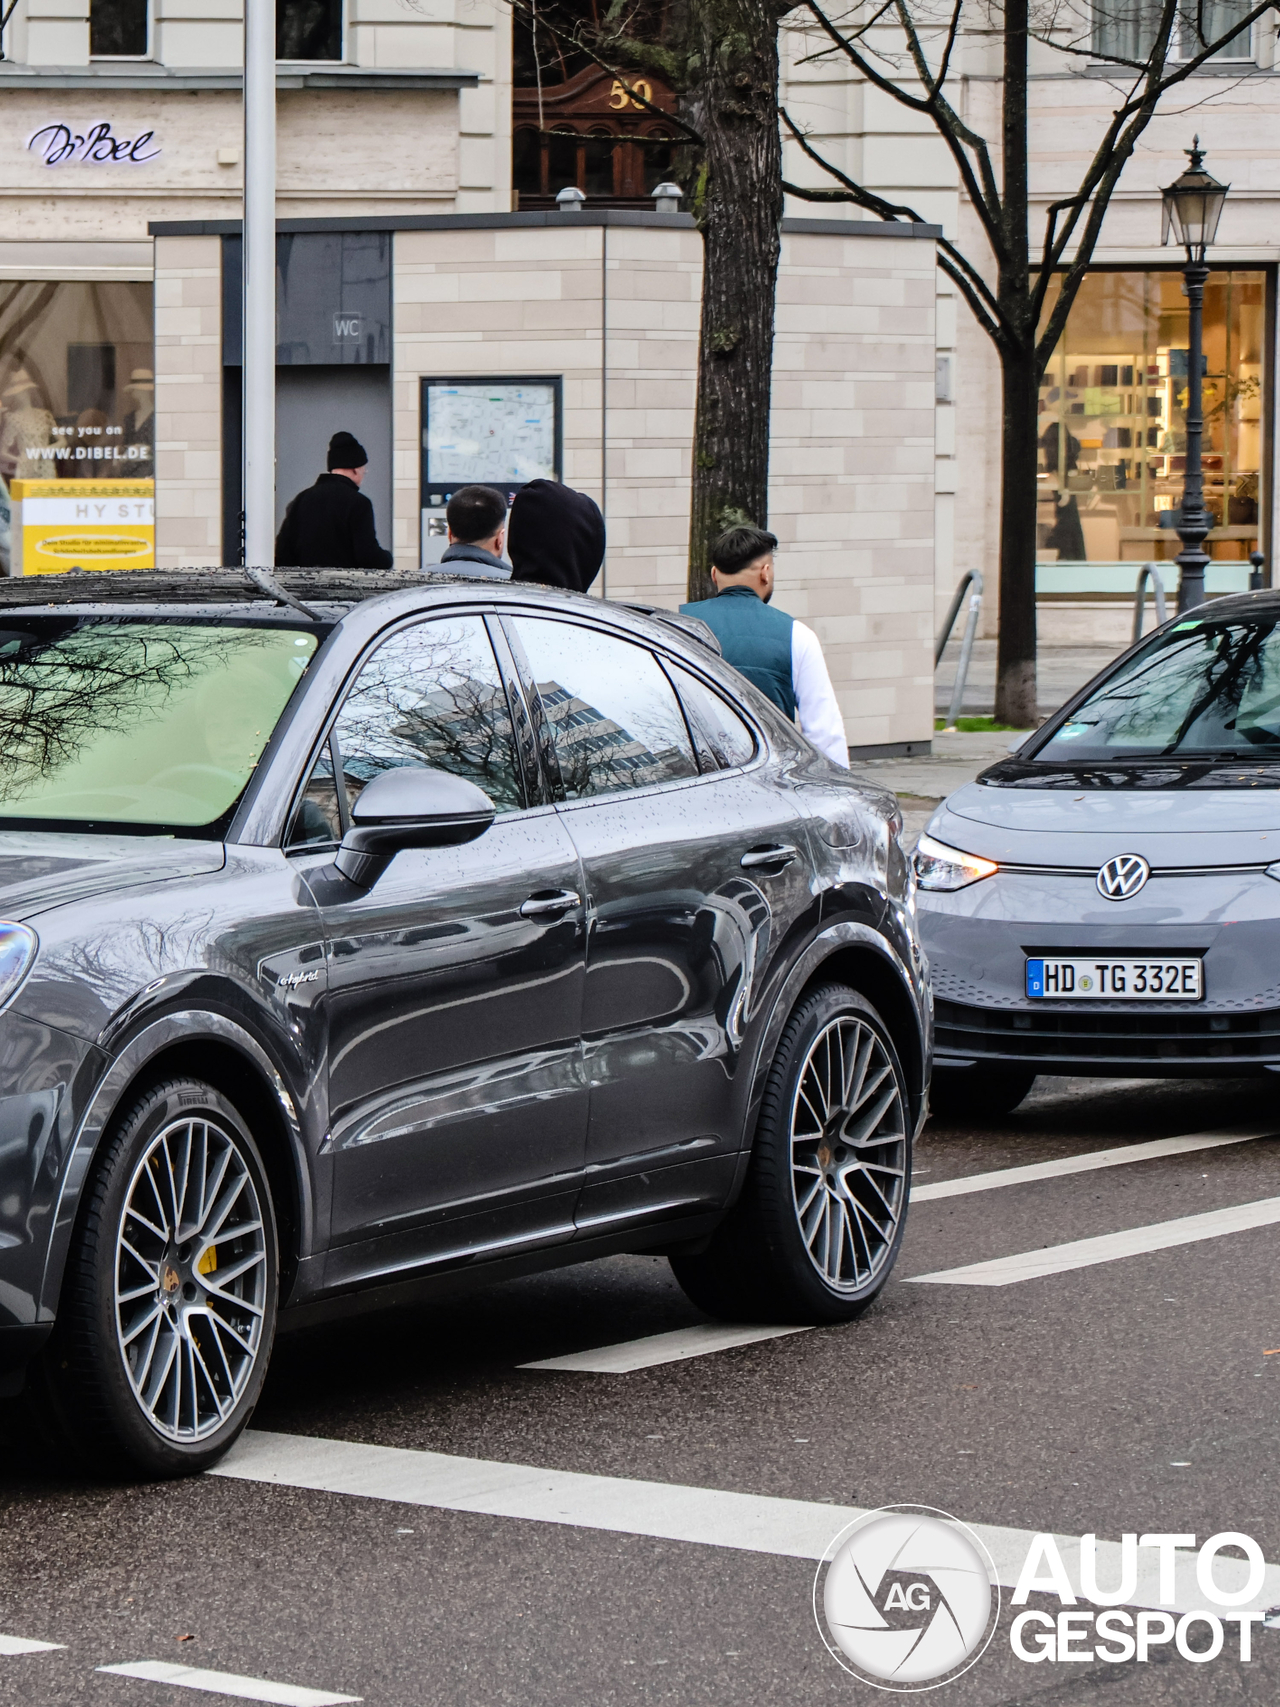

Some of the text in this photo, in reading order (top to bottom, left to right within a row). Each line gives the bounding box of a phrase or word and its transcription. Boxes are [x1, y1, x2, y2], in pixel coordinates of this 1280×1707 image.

[609, 80, 652, 110] 50
[335, 320, 359, 337] WC
[51, 425, 123, 438] see you on
[25, 446, 149, 460] WWW.DIBEL.DE
[1044, 964, 1075, 993] HD
[1095, 964, 1126, 993] TG
[1133, 964, 1197, 994] 332E
